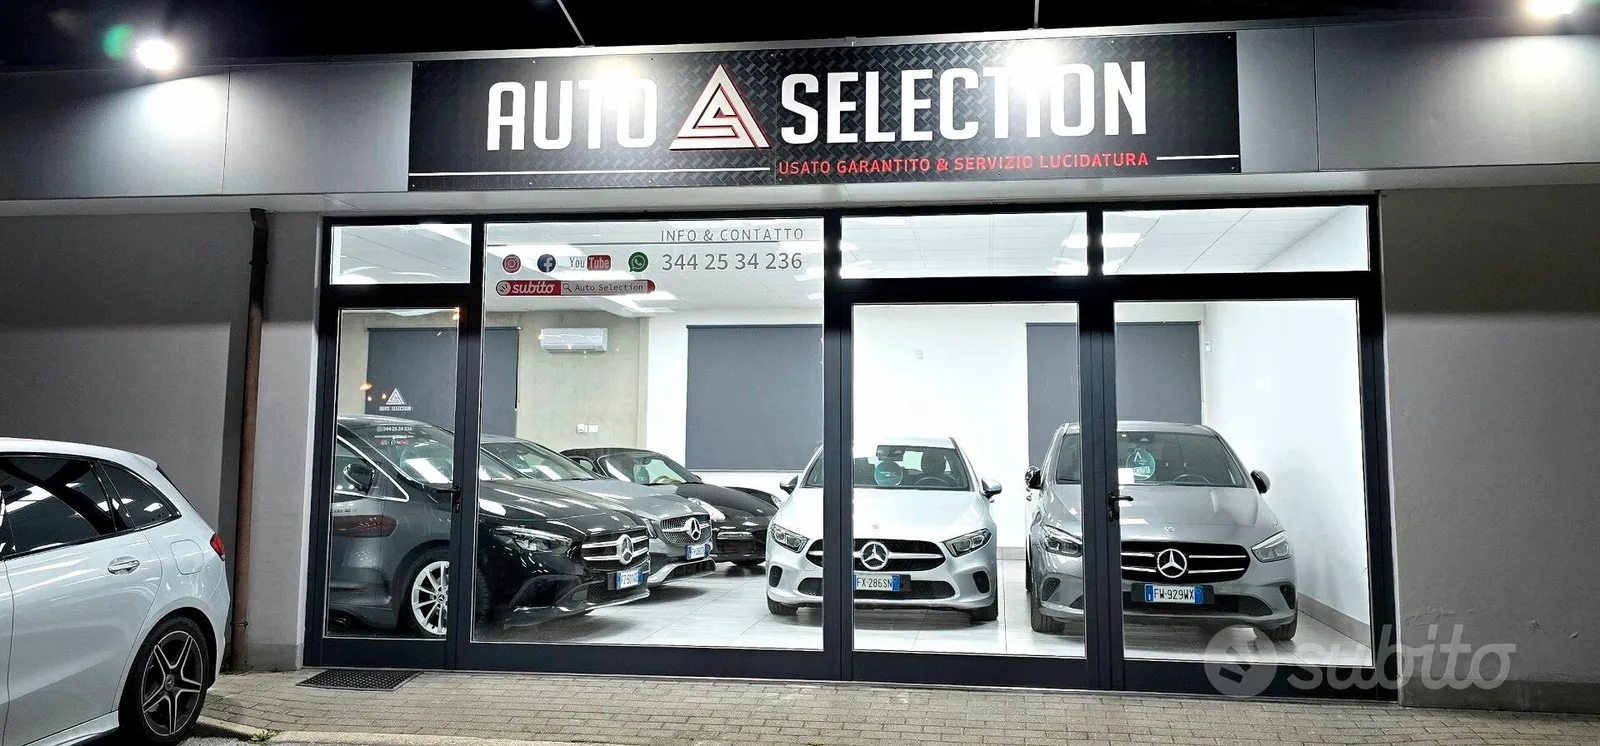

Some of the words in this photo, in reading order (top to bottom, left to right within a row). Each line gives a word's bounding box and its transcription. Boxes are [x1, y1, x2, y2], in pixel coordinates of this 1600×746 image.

[487, 78, 657, 151] AUTO
[780, 61, 1147, 145] SELECTION
[778, 160, 831, 175] USATO
[836, 158, 931, 174] GARANTITO
[936, 157, 949, 172] &
[954, 155, 1034, 171] SERVIZIO
[1039, 152, 1149, 169] LUCIDATURA
[661, 229, 697, 242] INFO
[703, 229, 714, 242] &
[720, 228, 804, 241] CONTATTO
[661, 253, 698, 271] 344
[704, 253, 728, 270] 25
[735, 252, 759, 270] 34
[765, 252, 803, 270] 236
[512, 280, 555, 294] subito
[574, 284, 594, 292] Auto
[598, 283, 644, 292] Selection
